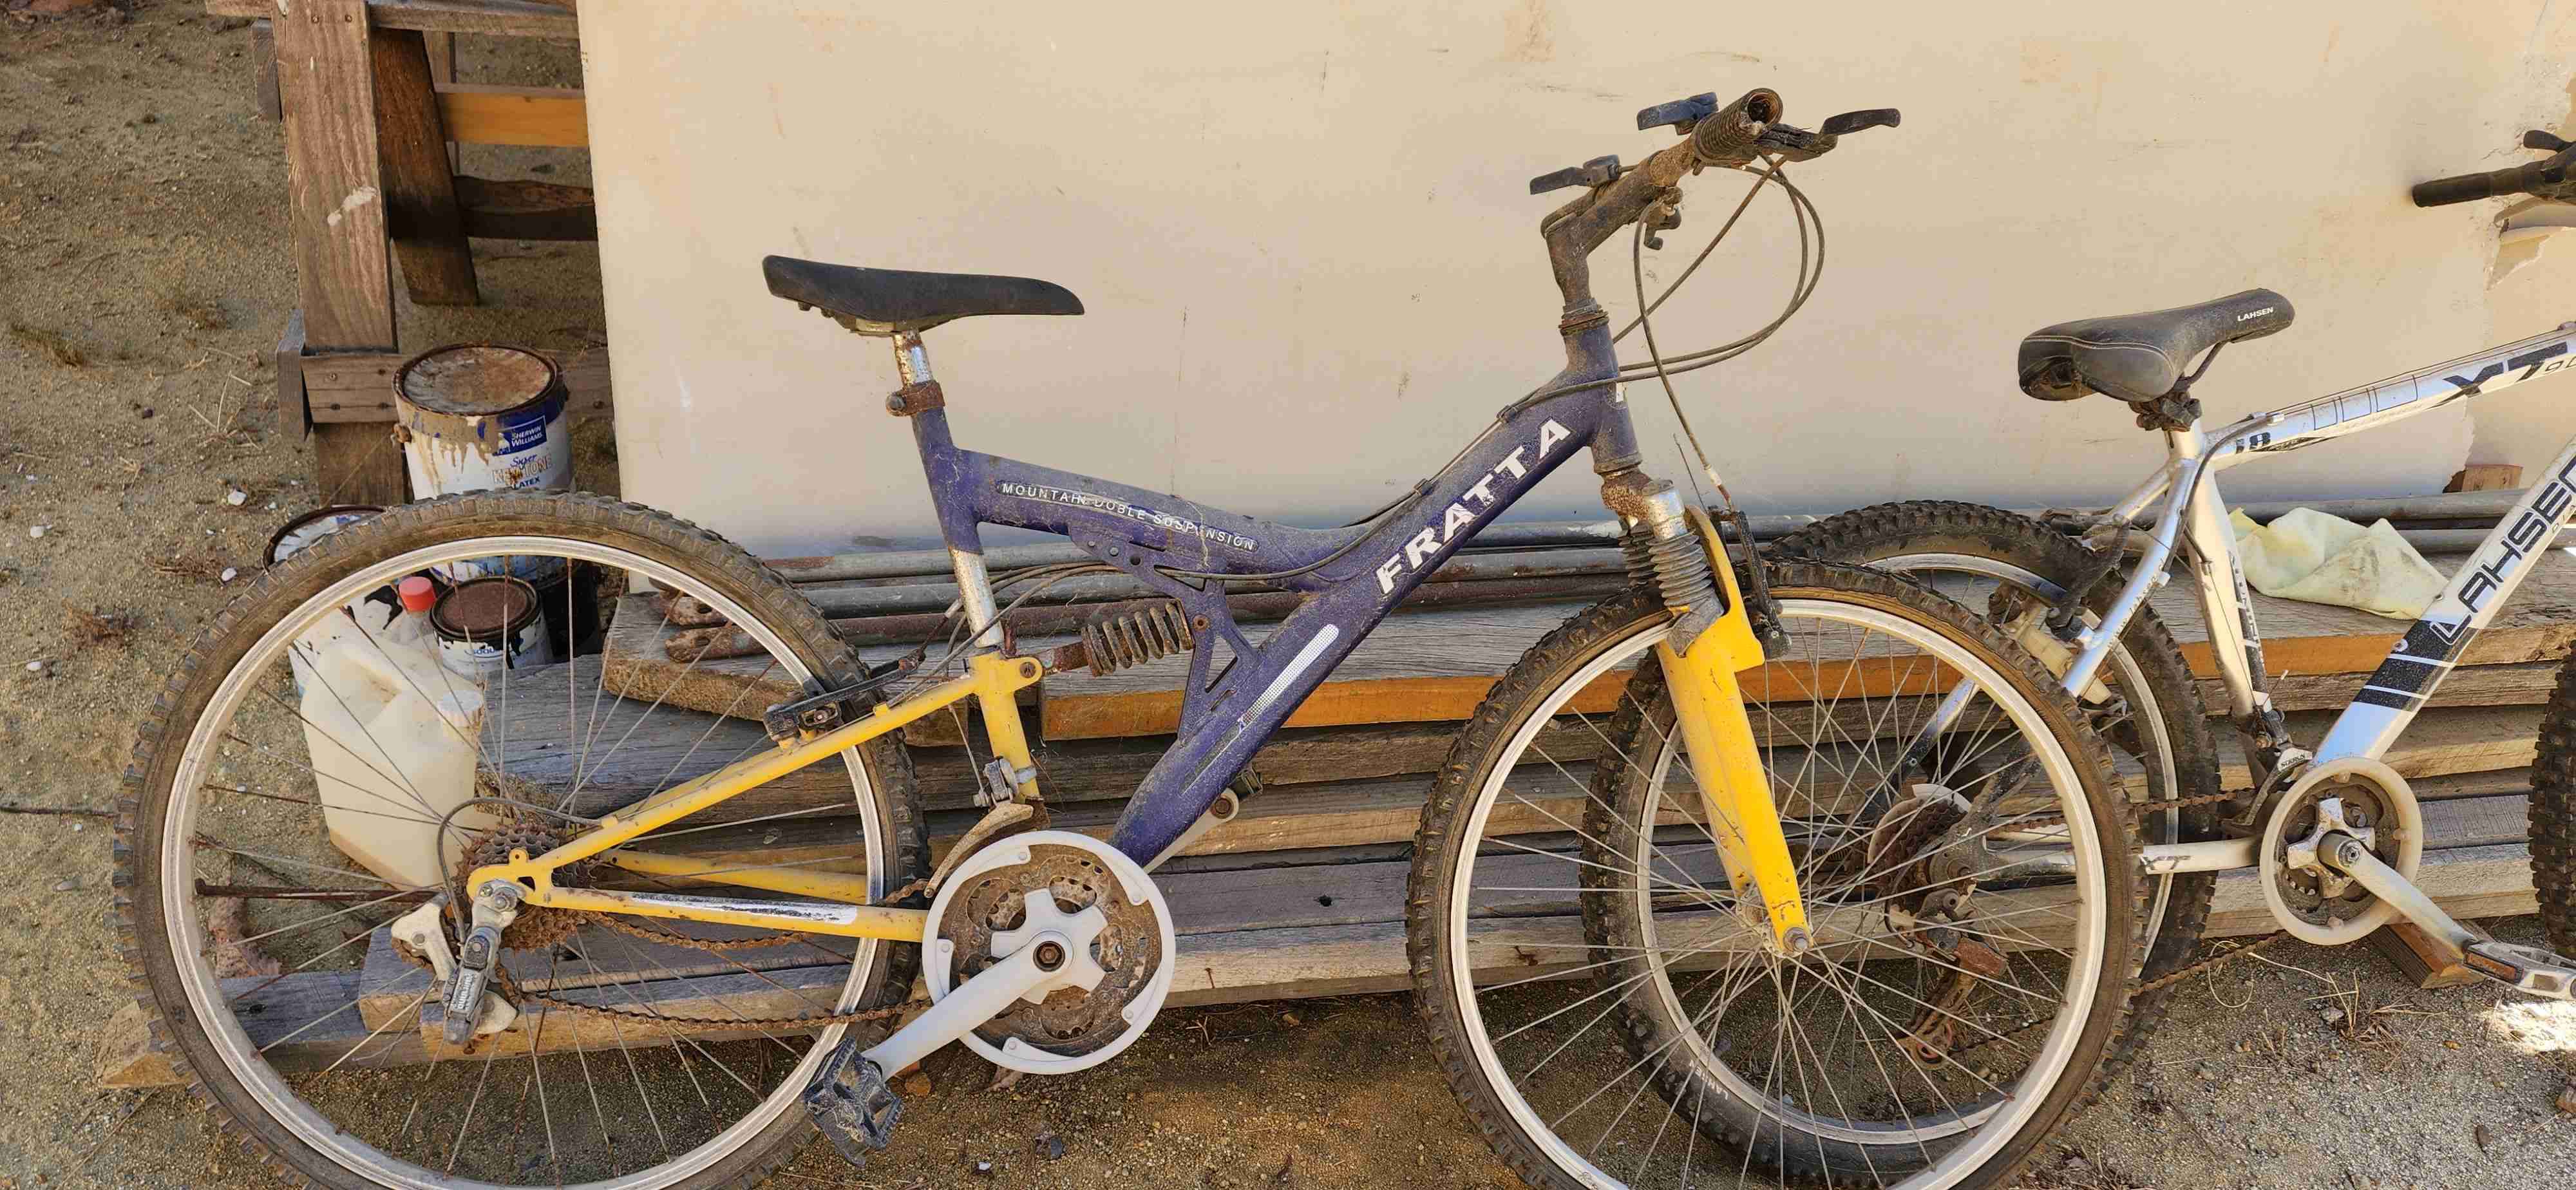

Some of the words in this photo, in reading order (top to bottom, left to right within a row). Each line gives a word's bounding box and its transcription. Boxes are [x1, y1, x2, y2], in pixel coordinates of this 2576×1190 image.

[2237, 307, 2273, 321] LAHSEN
[511, 433, 543, 447] WILLIAMS
[512, 426, 542, 440] SHERWIN
[1002, 483, 1088, 506] MOUNTAIN
[1095, 499, 1145, 520] DOBLE
[1376, 418, 1571, 595] FRATTA
